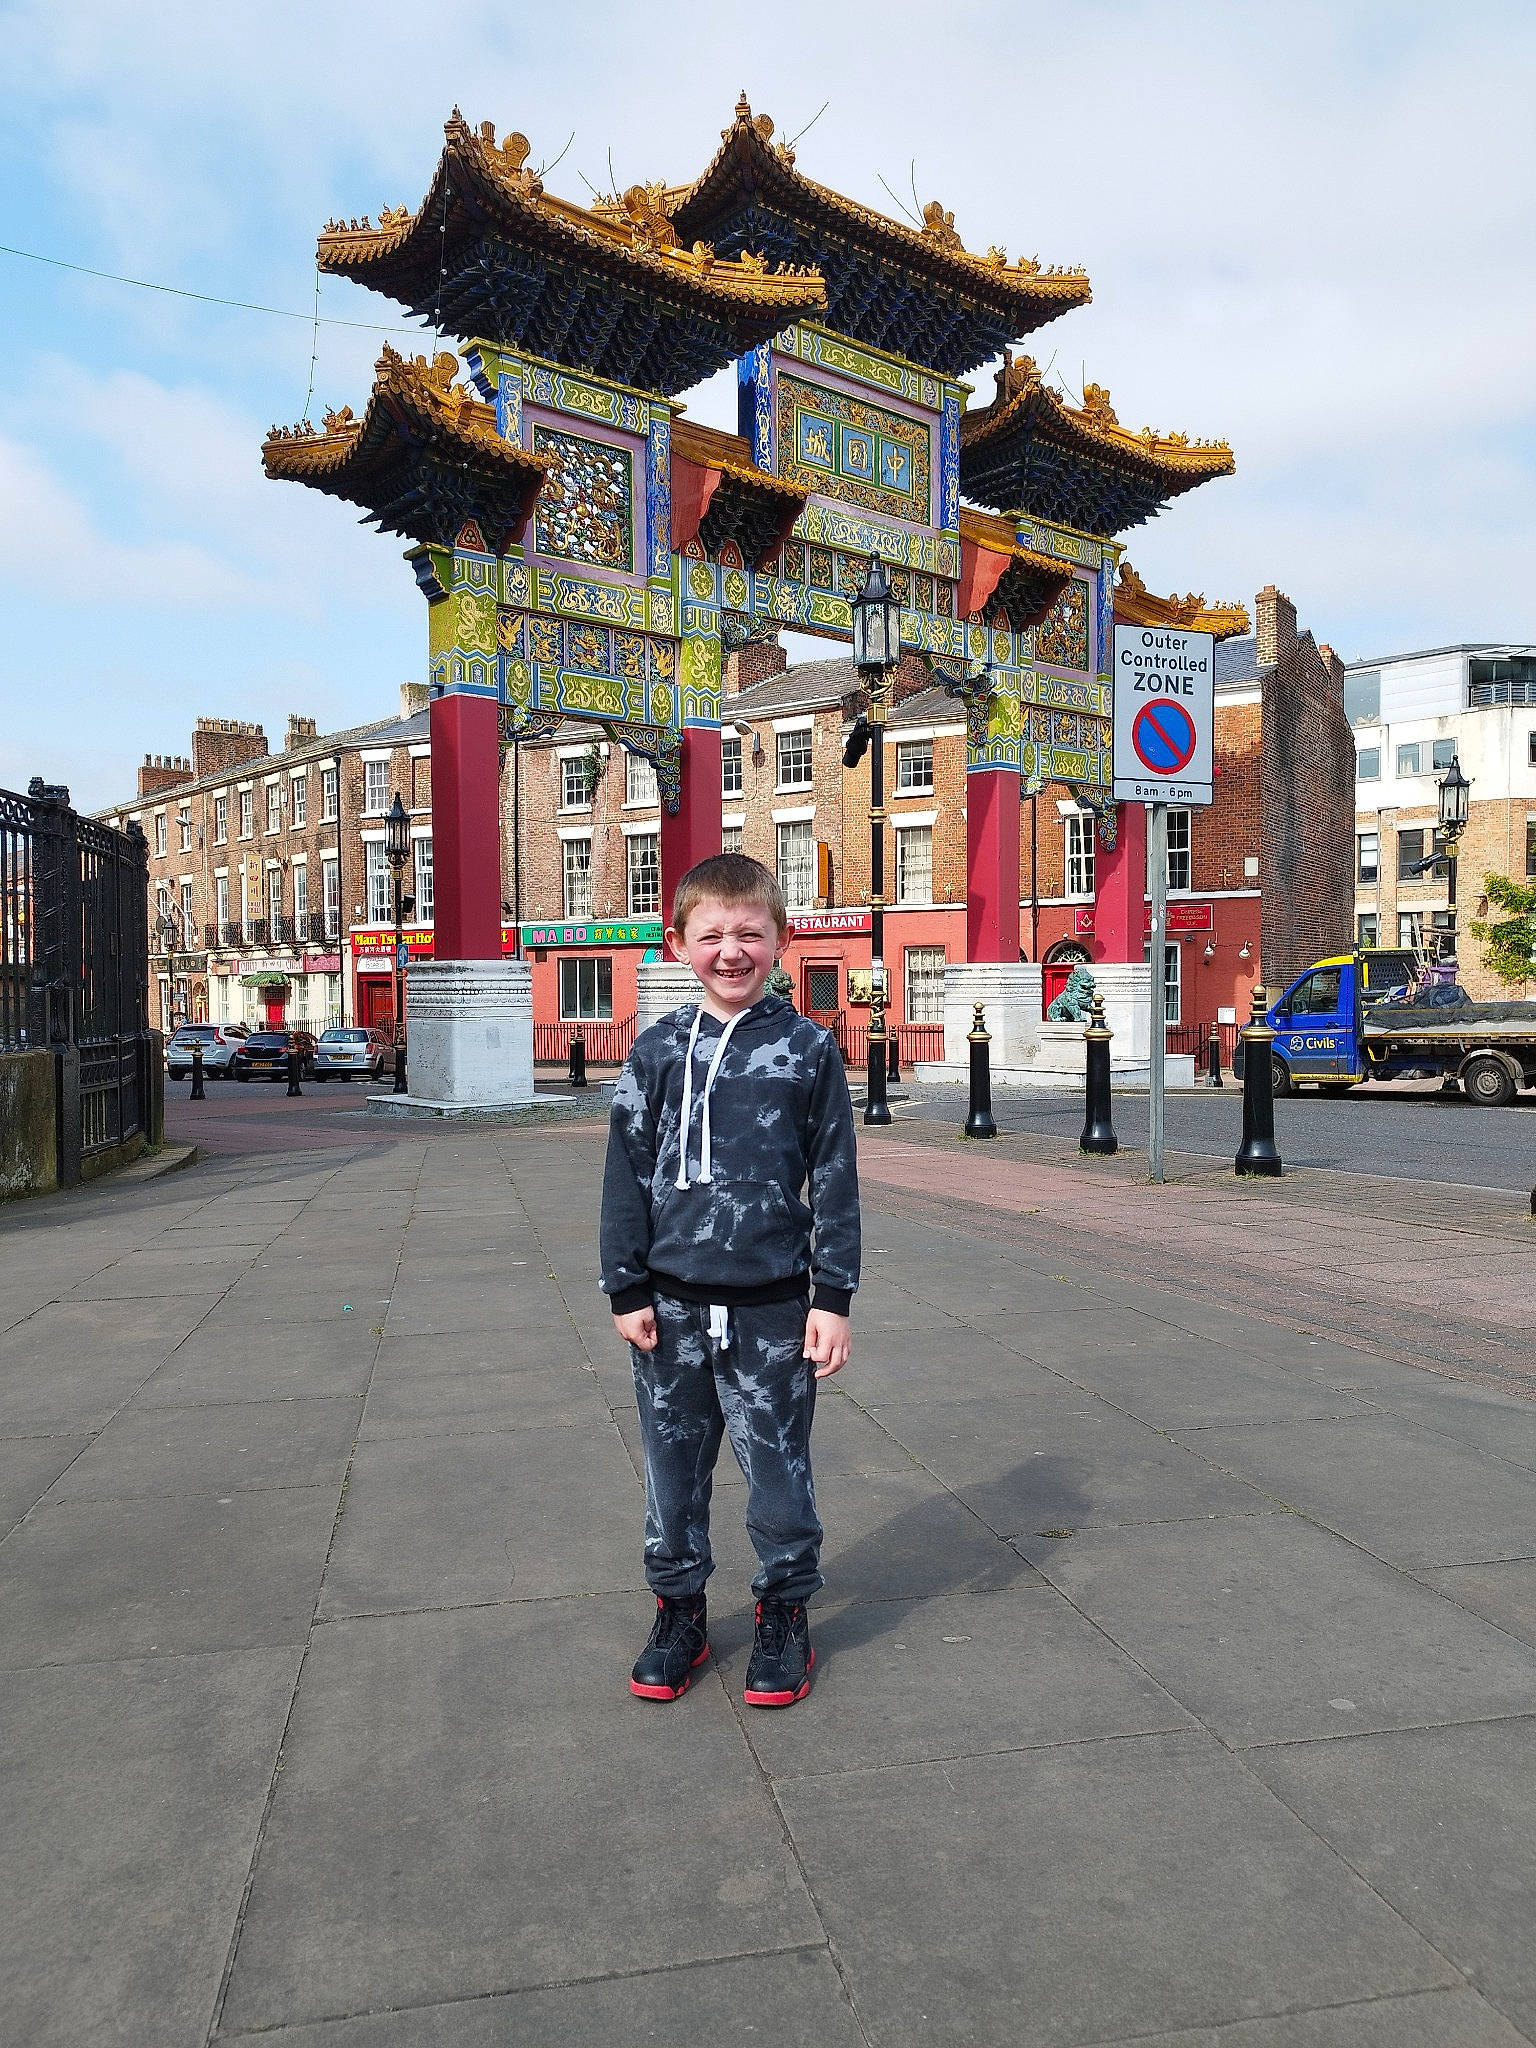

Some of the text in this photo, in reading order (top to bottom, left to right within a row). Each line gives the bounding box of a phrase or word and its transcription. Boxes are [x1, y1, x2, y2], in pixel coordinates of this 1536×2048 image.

[1141, 631, 1188, 651] Outer
[1120, 650, 1208, 672] Controlled
[1133, 671, 1194, 695] ZONE
[354, 934, 379, 945] Man
[532, 929, 558, 944] MA
[563, 927, 587, 942] BO
[1305, 1036, 1336, 1049] Civils
